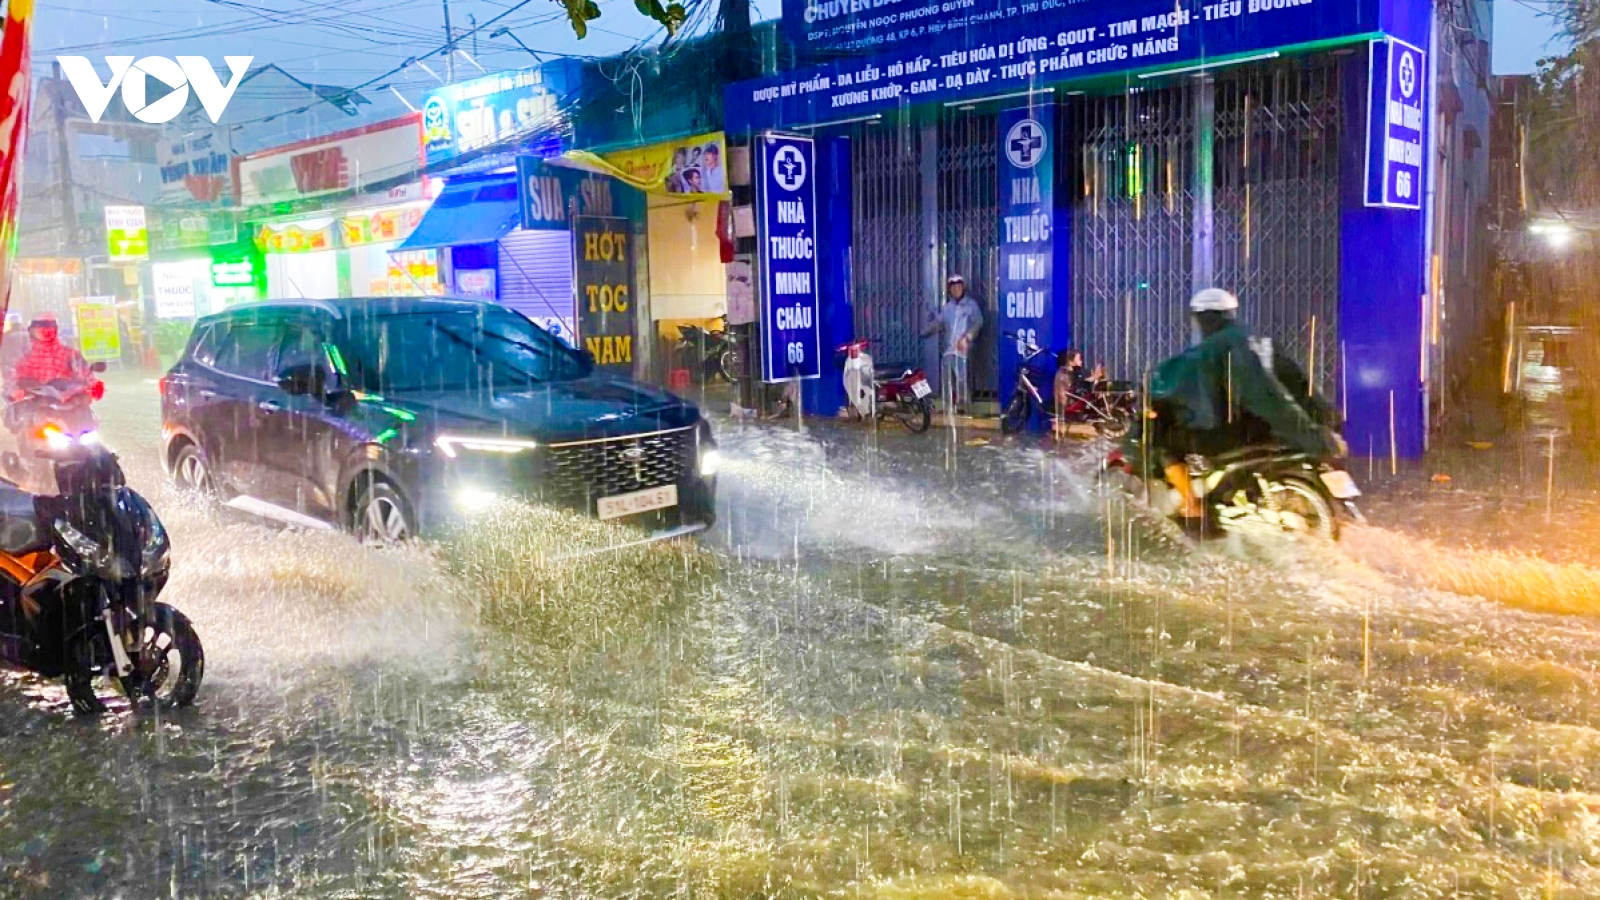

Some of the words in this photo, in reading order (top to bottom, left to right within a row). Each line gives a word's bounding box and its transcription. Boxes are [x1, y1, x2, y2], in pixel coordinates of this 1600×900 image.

[869, 14, 897, 28] NGỌC
[753, 85, 780, 103] DƯỢC
[781, 81, 797, 97] MỸ
[799, 73, 831, 94] PHẨM
[838, 73, 853, 87] DA
[887, 60, 904, 78] HÔ
[905, 55, 931, 74] HẤP
[940, 51, 968, 68] TIÊU
[969, 44, 996, 63] HÓA
[998, 43, 1014, 59] DỊ
[1017, 36, 1048, 54] ỨNG
[1057, 27, 1097, 47] GOUT
[1107, 19, 1138, 38] TIM
[1141, 9, 1190, 32] MẠCH
[831, 90, 869, 108] XƯƠNG
[871, 82, 903, 101] KHỚP
[910, 79, 937, 94] GAN
[946, 74, 964, 90] DẠ
[966, 67, 991, 85] DÀY
[1000, 60, 1036, 80] THỰC
[1040, 47, 1084, 73] PHẨM
[1086, 43, 1128, 64] CHỨC
[1132, 37, 1179, 58] NĂNG
[1396, 170, 1411, 199] 66
[777, 196, 806, 224] NHÀ
[1004, 208, 1049, 243] THUỐC
[770, 229, 813, 259] THUỐC
[1008, 254, 1045, 280] MINH
[775, 272, 811, 295] MINH
[776, 302, 812, 330] CHÂU
[1006, 287, 1044, 319] CHÂU
[585, 335, 632, 365] NAM
[787, 342, 805, 364] 66
